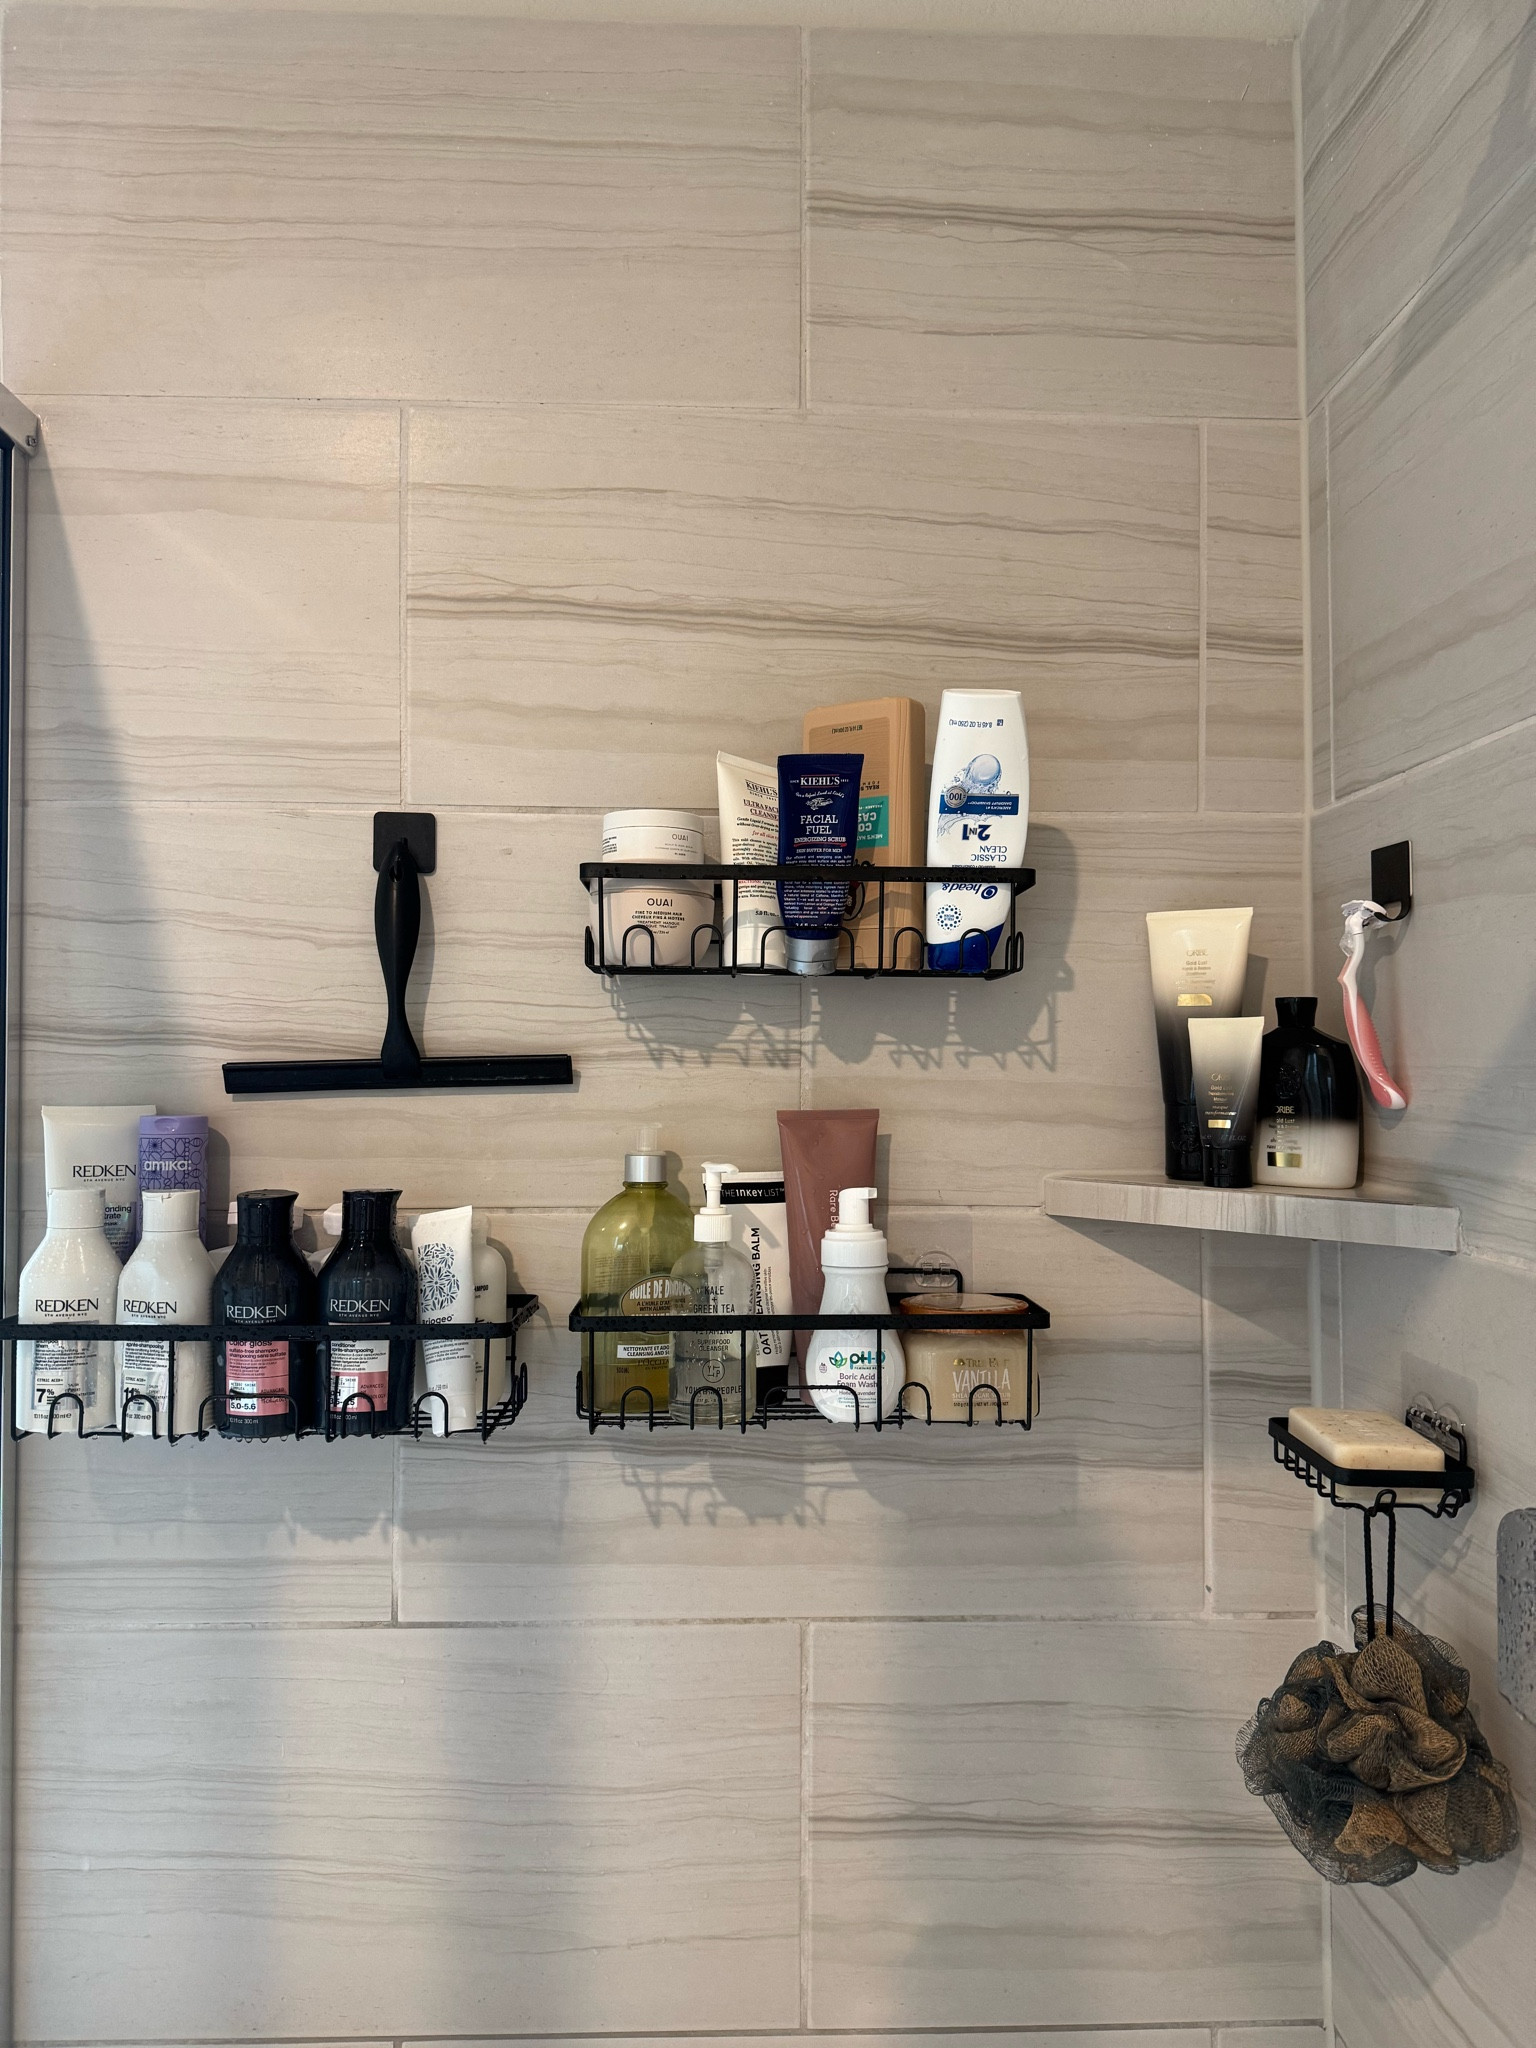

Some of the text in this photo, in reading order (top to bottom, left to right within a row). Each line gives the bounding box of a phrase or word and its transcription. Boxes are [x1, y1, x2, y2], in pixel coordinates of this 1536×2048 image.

[800, 776, 840, 786] KIEHL'S
[745, 781, 778, 796] KIEHL'S
[749, 808, 779, 820] CLEANSE
[800, 814, 839, 825] FACIAL
[805, 825, 832, 835] FUEL
[671, 833, 689, 842] OUAI
[794, 836, 827, 844] ENERGIZING
[980, 845, 1008, 854] CLEAN
[970, 853, 1007, 863] CLASSIC
[948, 883, 983, 895] head
[646, 897, 673, 907] OUAI
[72, 1164, 137, 1178] REDKEN
[721, 1189, 736, 1198] THE
[829, 1189, 839, 1213] Rare
[104, 1205, 132, 1214] onding
[630, 1279, 663, 1300] HUILE DE
[704, 1285, 725, 1296] KALE
[750, 1227, 772, 1355] OAT EANSING BALM
[35, 1297, 99, 1313] REDKEN
[123, 1299, 177, 1315] REDKEN
[329, 1298, 391, 1313] REDKEN
[693, 1303, 736, 1314] GREEN TEA
[226, 1303, 288, 1319] REDKEN
[839, 1372, 876, 1380] Boric Acid
[952, 1368, 1011, 1393] VANILLA
[836, 1380, 878, 1388] Foam Wash
[230, 1403, 257, 1411] 5.0-5.6
